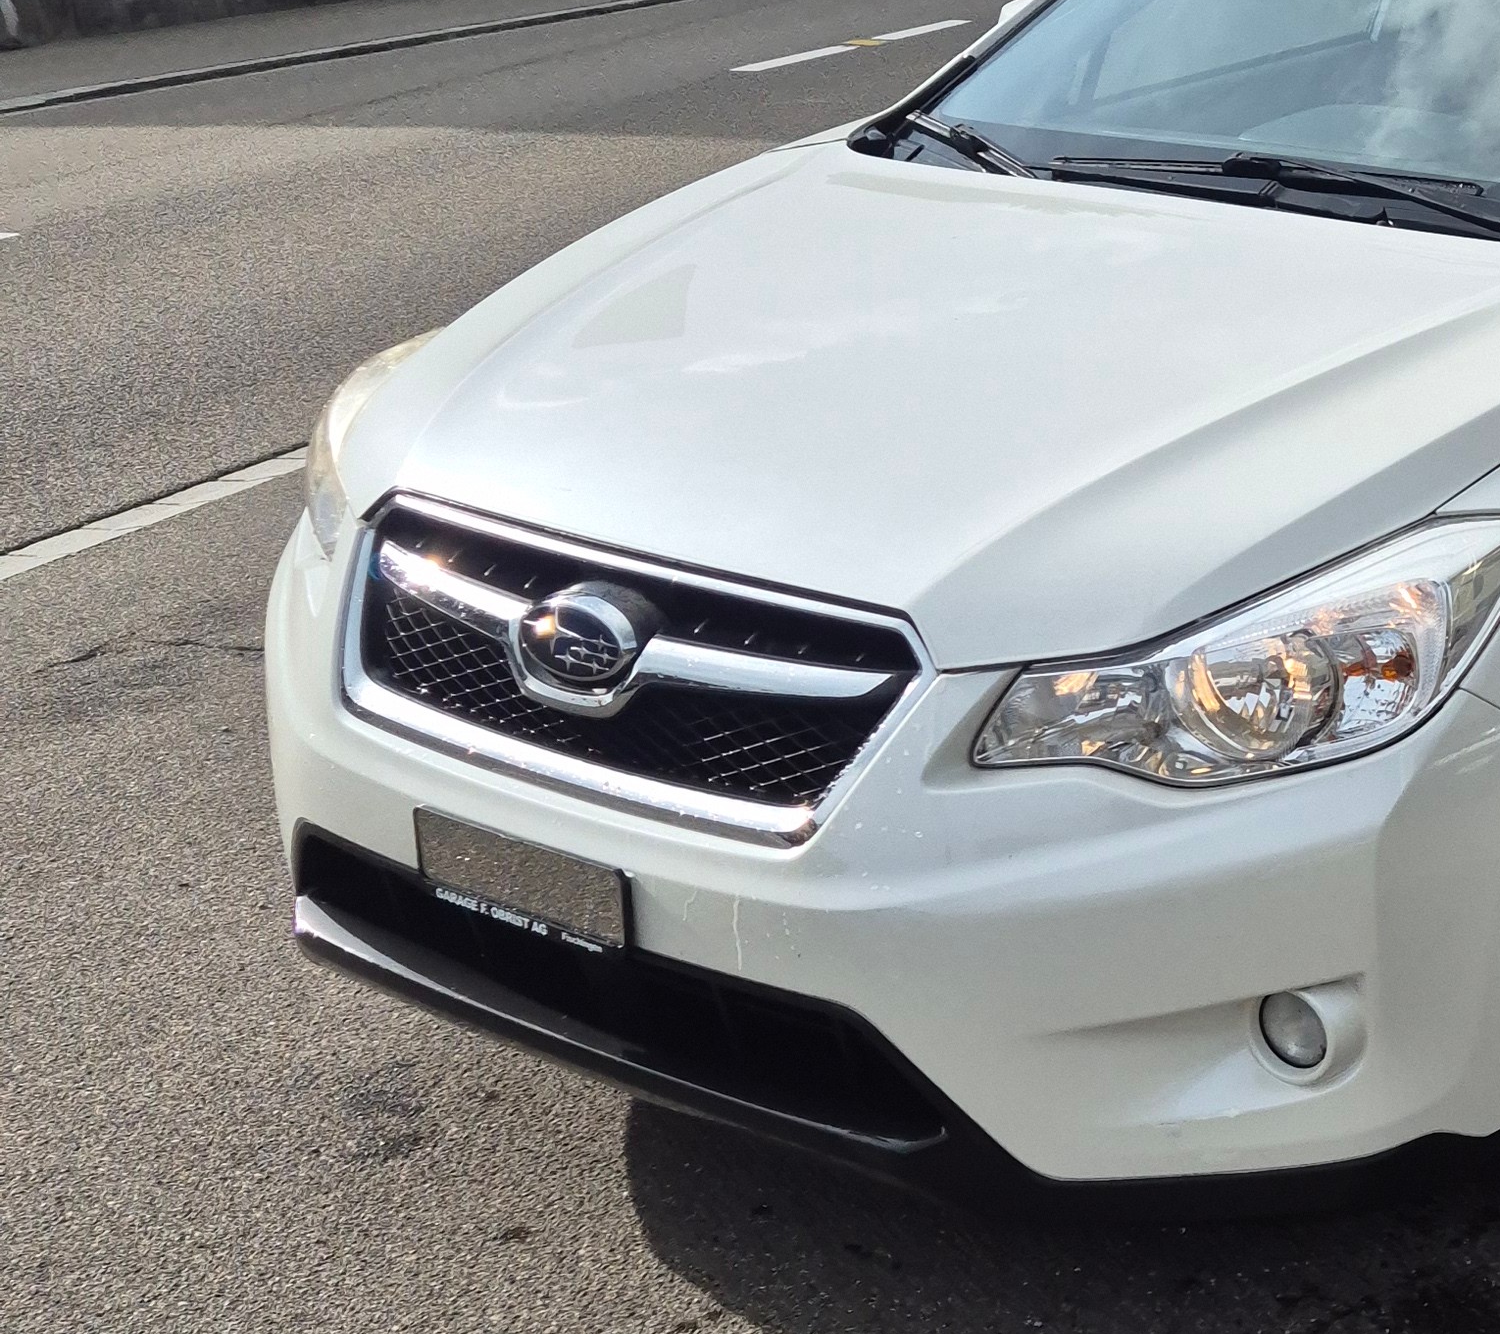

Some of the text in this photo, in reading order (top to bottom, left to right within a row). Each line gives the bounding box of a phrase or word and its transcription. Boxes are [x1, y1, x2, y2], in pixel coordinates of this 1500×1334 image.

[435, 887, 479, 911] GARAGE
[480, 903, 489, 915] F.
[490, 907, 530, 929] OBRIST
[531, 922, 548, 936] AG
